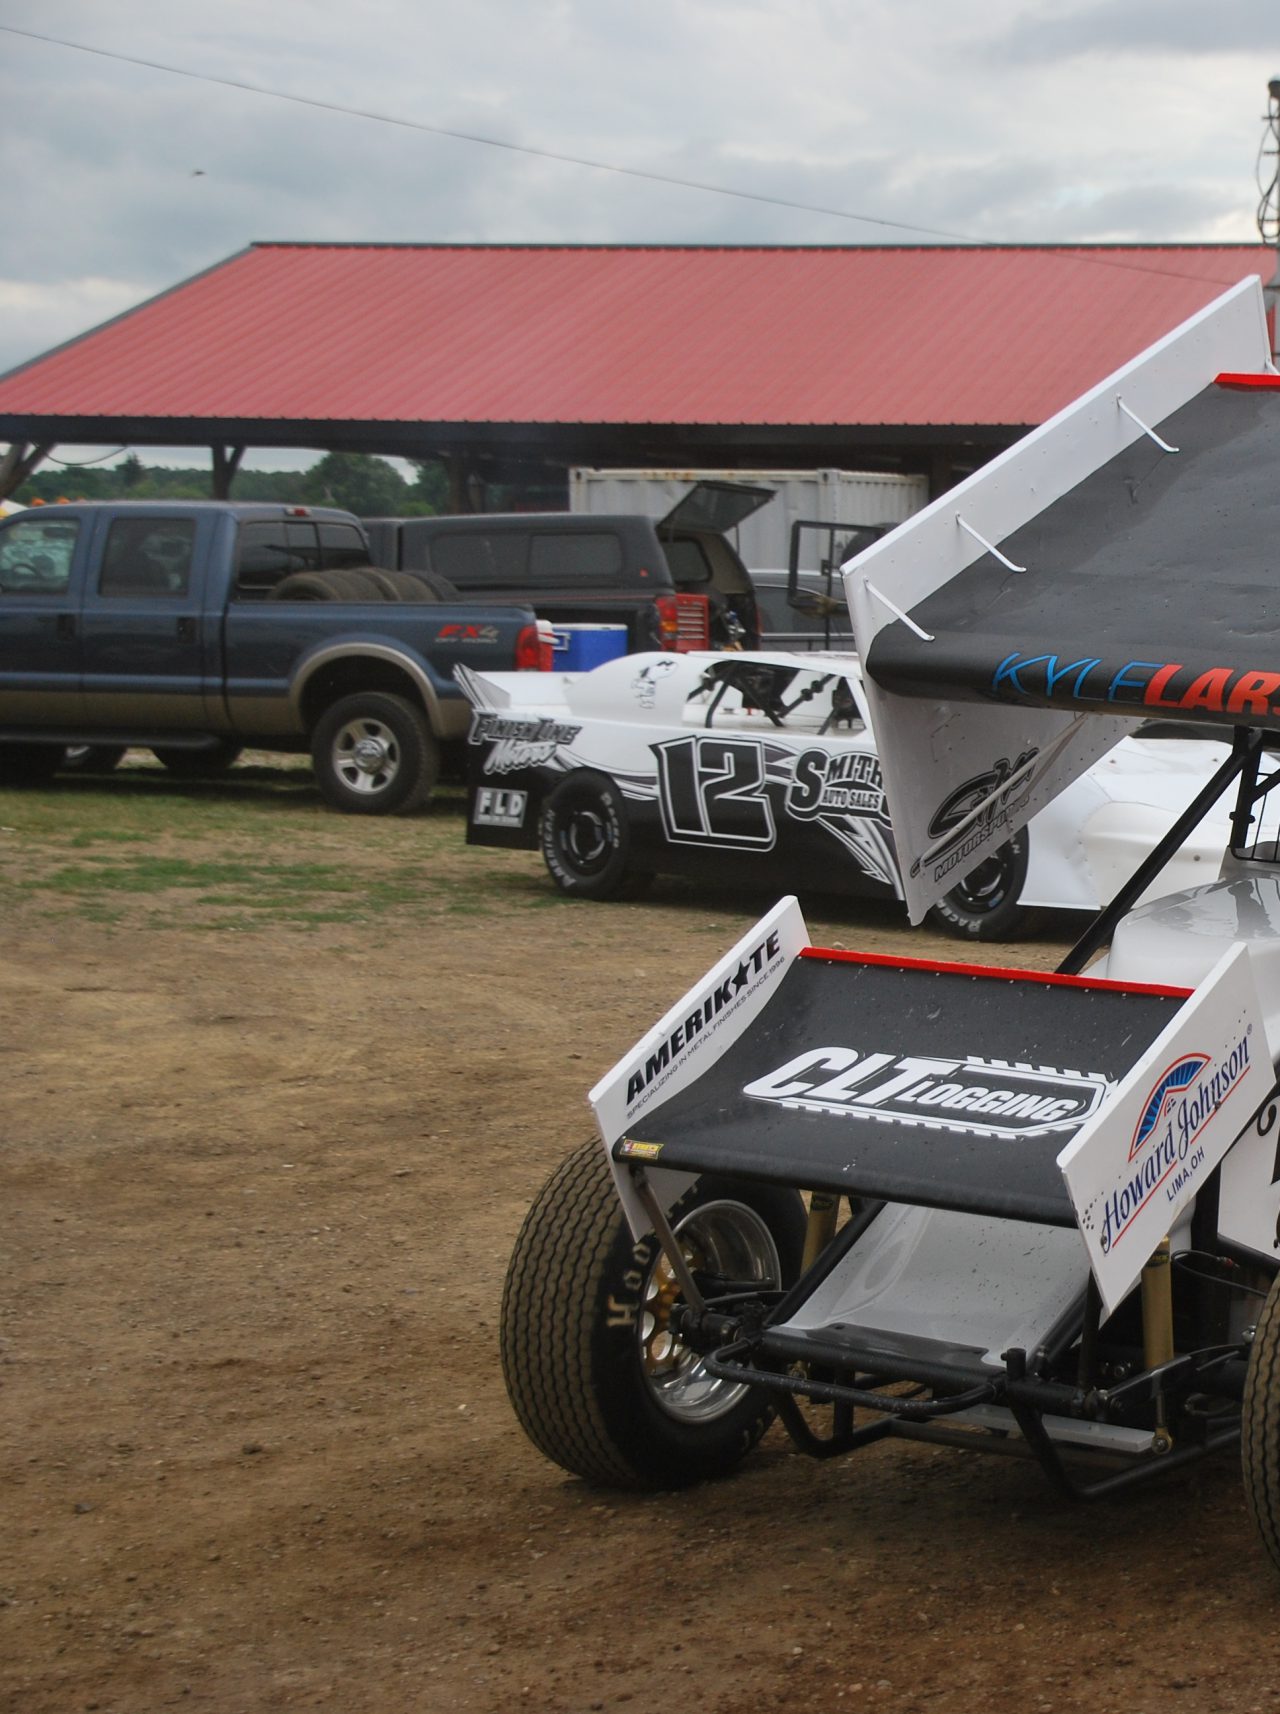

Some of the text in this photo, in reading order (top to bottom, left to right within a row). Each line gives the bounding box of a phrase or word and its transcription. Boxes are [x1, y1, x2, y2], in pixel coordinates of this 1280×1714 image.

[437, 624, 499, 639] FX4
[992, 652, 1164, 701] KYLE
[479, 791, 523, 816] FLD
[652, 737, 775, 848] 12
[822, 789, 880, 809] AUTO SALES
[934, 793, 1031, 882] MOTORSPO
[627, 1064, 679, 1120] SPECIALIZING
[687, 1030, 713, 1057] METAL
[712, 995, 746, 1032] FINISHES
[746, 974, 770, 998] SINCE
[743, 1047, 1079, 1121] CLT LOGGING
[1101, 1034, 1250, 1255] Howard Johnson
